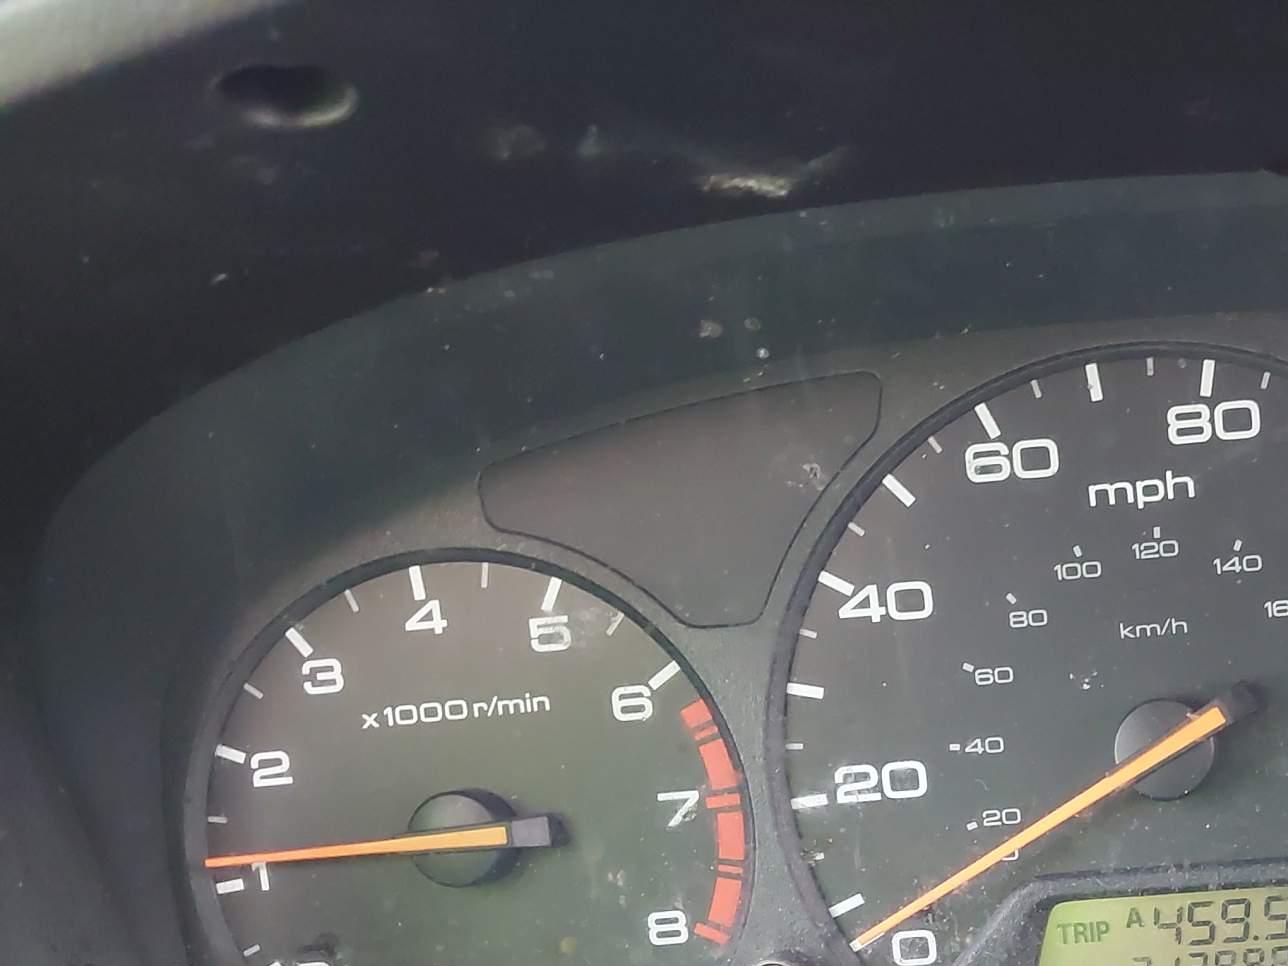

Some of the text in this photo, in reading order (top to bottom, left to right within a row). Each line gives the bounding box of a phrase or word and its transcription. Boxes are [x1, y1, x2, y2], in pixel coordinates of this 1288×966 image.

[1166, 400, 1261, 446] 80
[964, 438, 1060, 484] 60
[1088, 470, 1196, 510] mph
[1131, 539, 1179, 560] 120
[1213, 554, 1263, 575] 140
[1053, 561, 1102, 581] 100
[405, 600, 447, 635] 4
[838, 580, 934, 623] 40
[1009, 609, 1048, 628] 80
[529, 615, 572, 653] 5
[1120, 617, 1188, 640] km/h
[301, 658, 345, 696] 3
[974, 666, 1014, 686] 60
[361, 692, 551, 729] x1000 r/min
[611, 685, 653, 721] 6
[964, 736, 1004, 754] 40
[250, 750, 293, 788] 2
[833, 760, 928, 803] 20
[657, 790, 700, 827] 7
[982, 808, 1022, 826] 20
[251, 861, 270, 891] 1
[647, 910, 689, 946] 8
[1056, 921, 1110, 945] TRIP
[1126, 907, 1145, 929] A
[891, 929, 937, 966] 0
